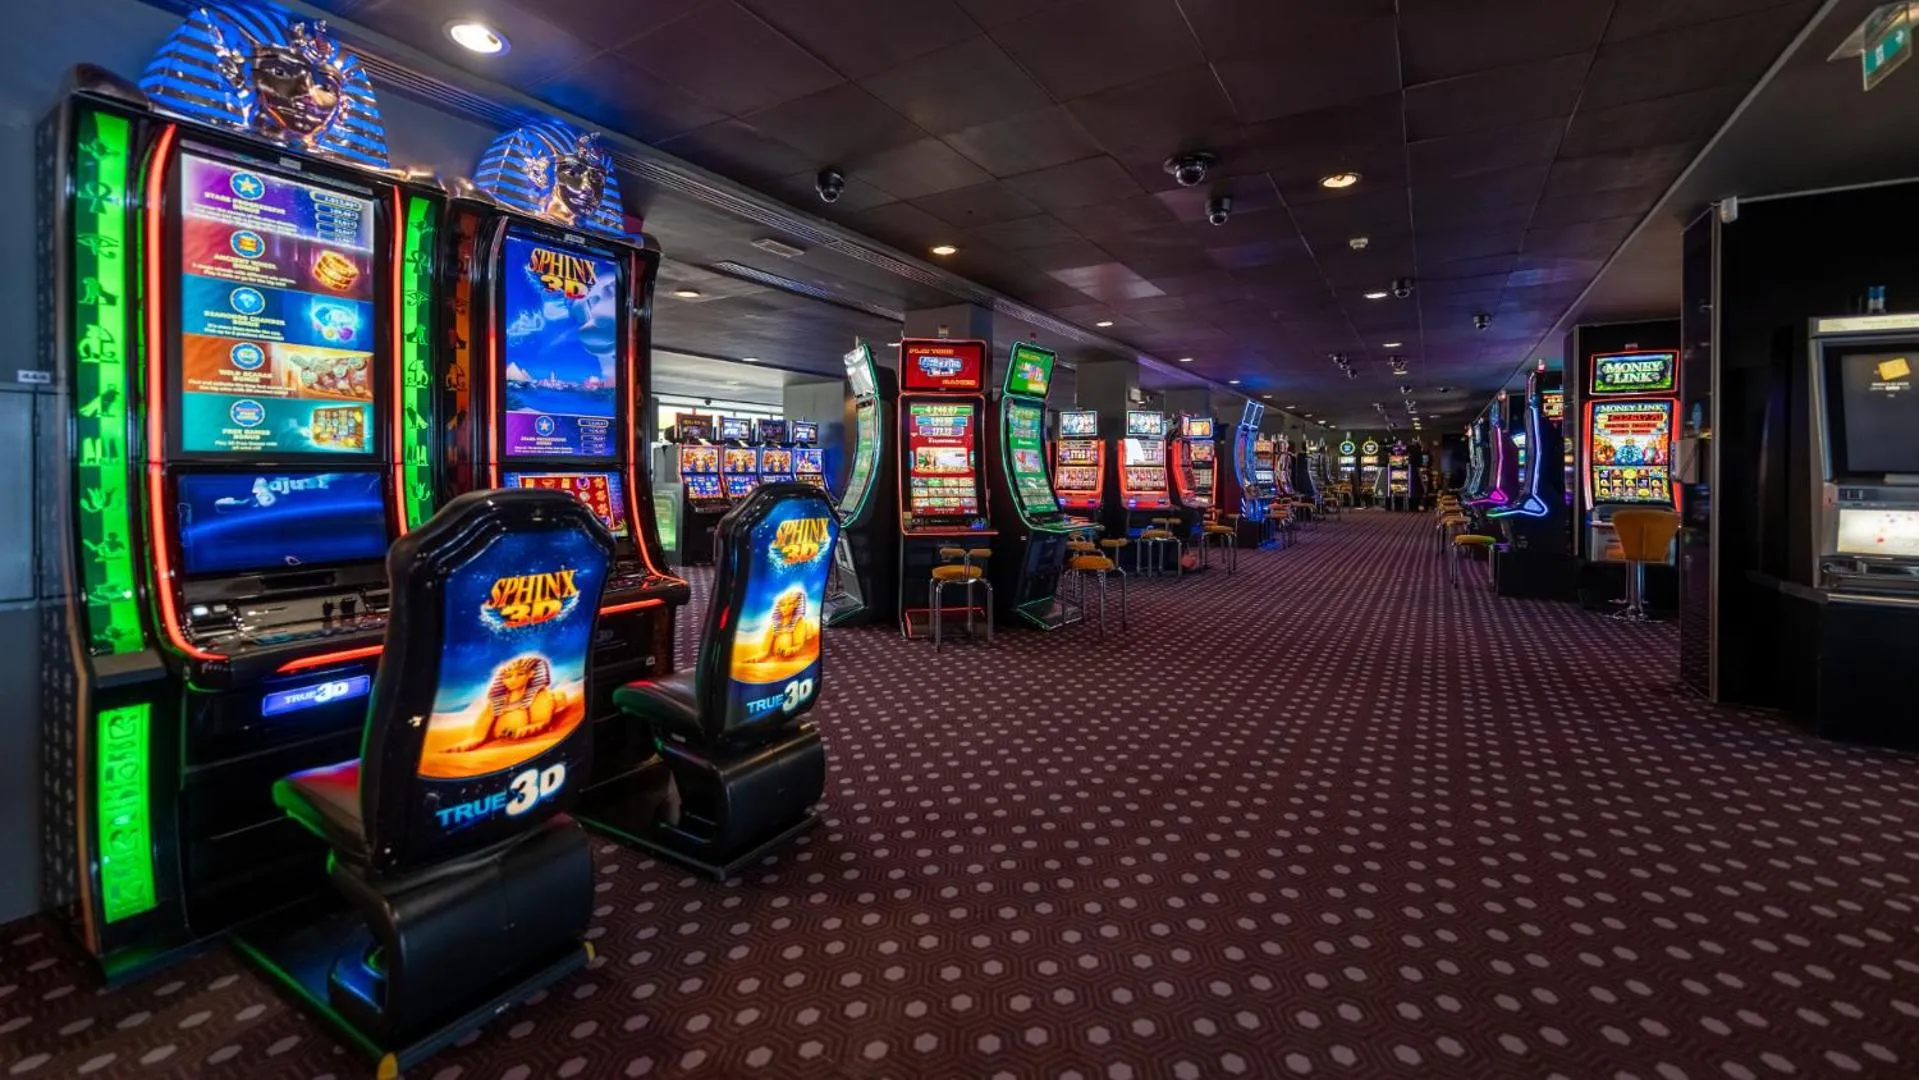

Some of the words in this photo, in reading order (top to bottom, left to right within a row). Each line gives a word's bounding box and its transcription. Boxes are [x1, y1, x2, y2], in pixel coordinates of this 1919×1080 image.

[528, 247, 597, 286] SPHINX
[541, 274, 589, 301] 3D
[1604, 360, 1664, 374] MONEY
[1612, 371, 1653, 385] LINK
[1600, 404, 1637, 412] MONEY
[775, 518, 830, 546] SPHINX
[781, 543, 820, 565] 3D
[488, 569, 580, 608] SPHINX
[500, 599, 563, 628] 3D
[435, 793, 508, 827] TRUE
[504, 763, 567, 816] 3D
